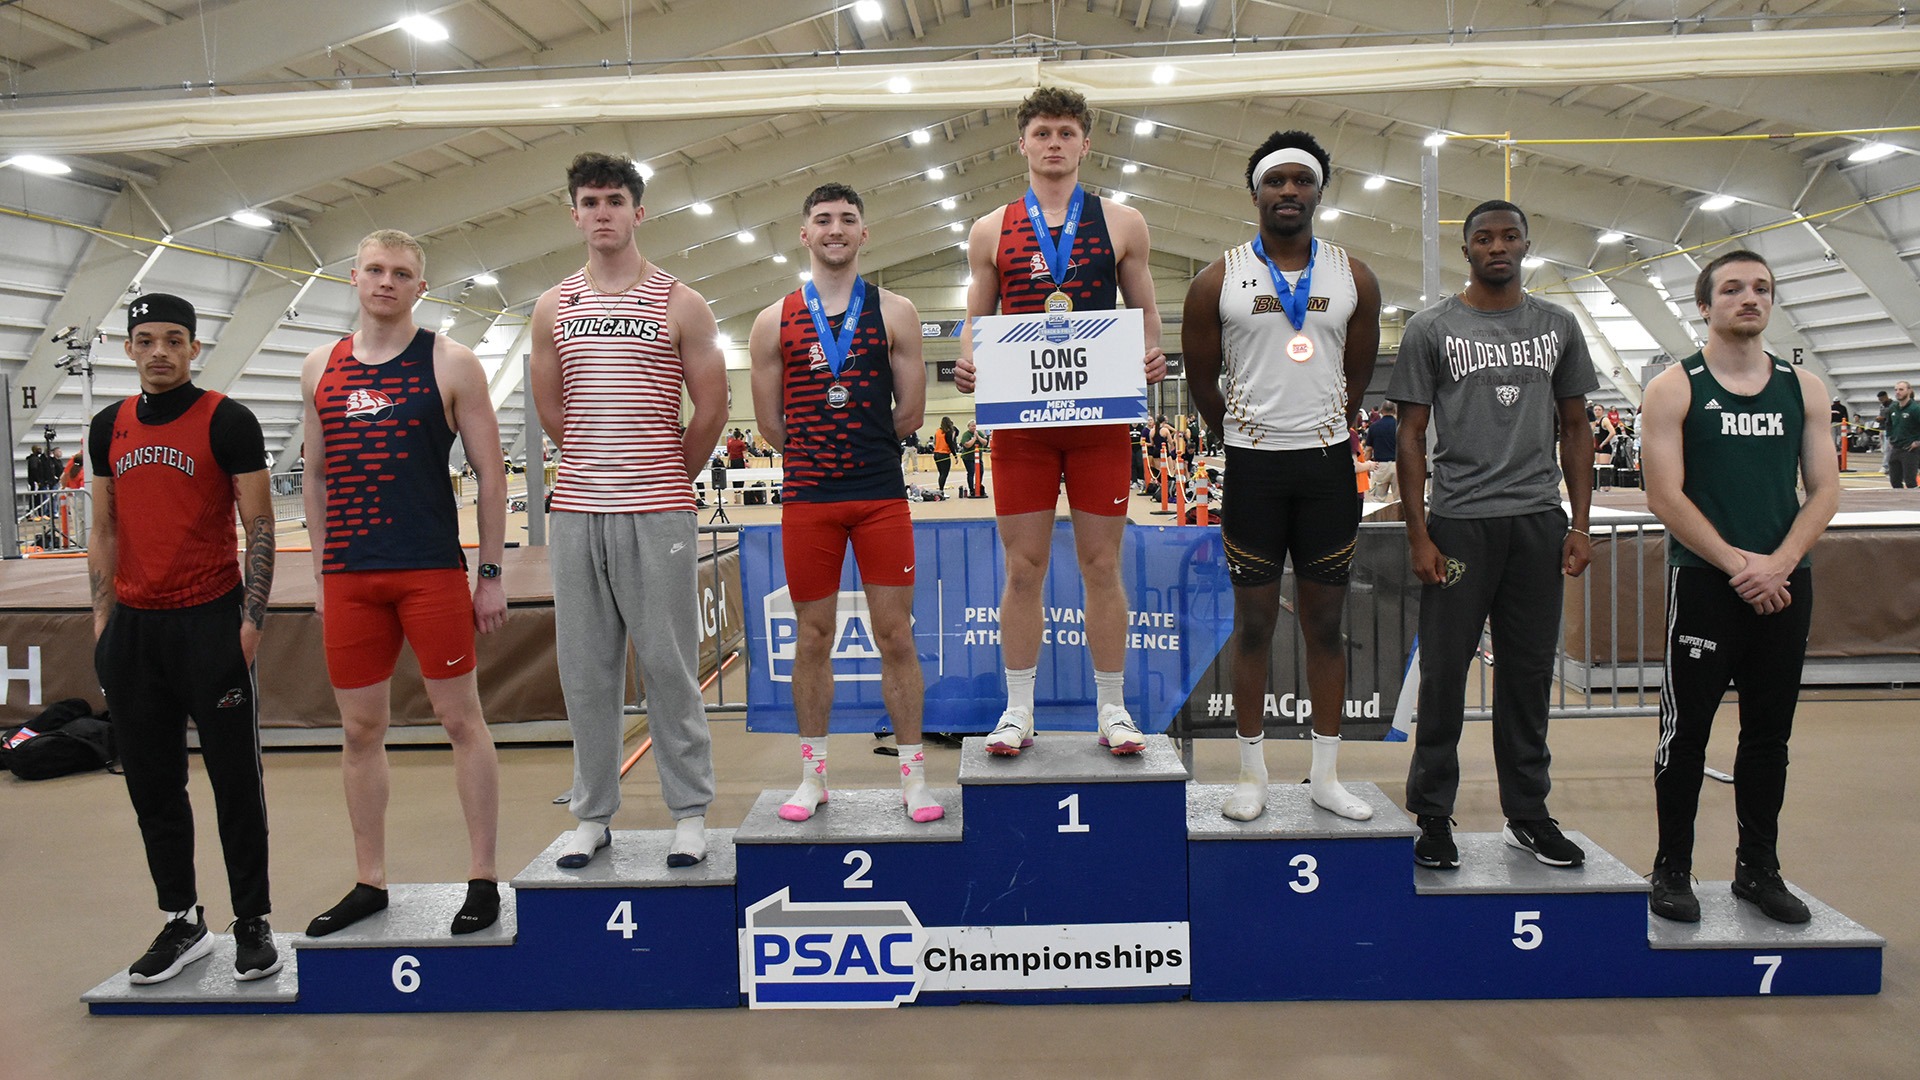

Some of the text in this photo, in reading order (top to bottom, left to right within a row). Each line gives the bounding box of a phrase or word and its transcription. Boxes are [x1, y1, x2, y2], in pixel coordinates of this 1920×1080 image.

[1251, 295, 1330, 314] BLM
[561, 318, 660, 341] VULCANS
[1030, 348, 1087, 370] LONG
[1446, 330, 1559, 382] GOLDEN BEARS
[1792, 348, 1803, 365] E
[1031, 371, 1088, 394] JUMP
[22, 386, 37, 409] H
[1046, 400, 1075, 409] MEN'S
[1019, 407, 1103, 422] CHAMPION
[1720, 412, 1784, 436] ROCK
[116, 446, 195, 478] MANSFIELD
[1127, 611, 1175, 629] TATE
[964, 629, 1051, 646] ATHC
[1678, 635, 1704, 648] SLIPPERY
[1704, 639, 1717, 650] ROCK
[1689, 647, 1702, 659] S
[0, 646, 41, 705] H
[1058, 793, 1090, 833] 1
[843, 850, 873, 888] 2
[1289, 854, 1320, 893] 3
[606, 901, 638, 938] 4
[1511, 911, 1543, 950] 5
[755, 933, 914, 976] PSAC
[923, 944, 1183, 977] Championships
[391, 955, 421, 993] 6
[1753, 956, 1782, 994] 7
